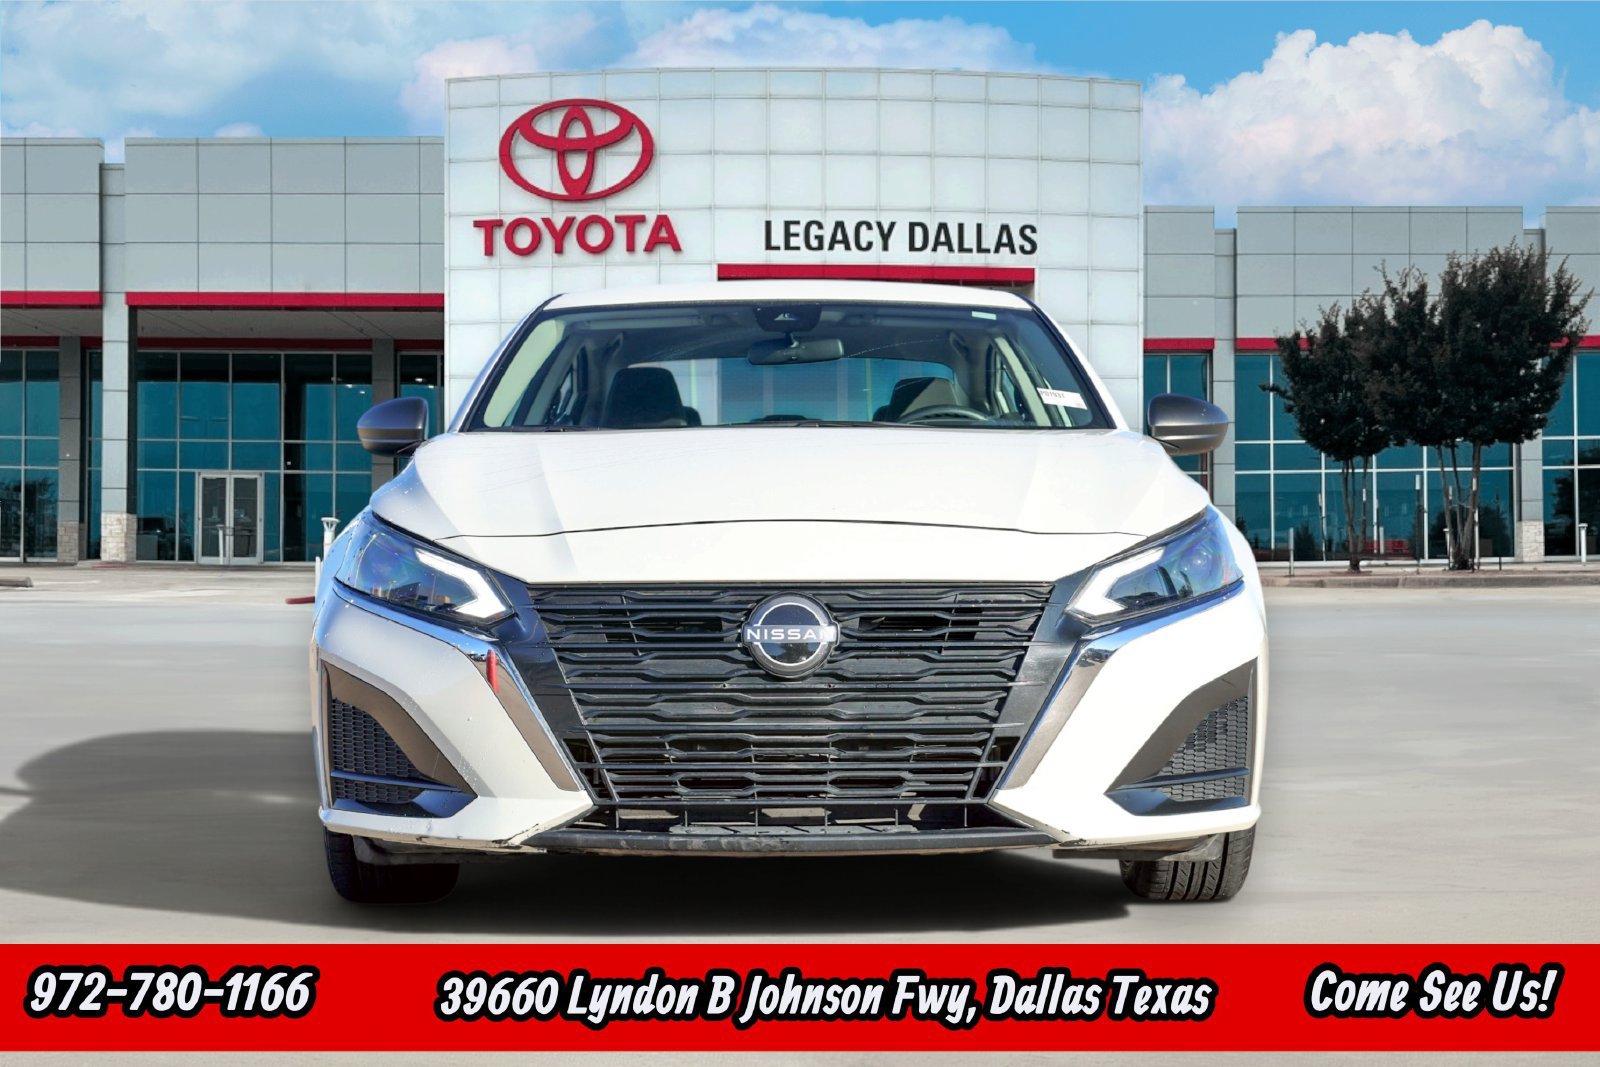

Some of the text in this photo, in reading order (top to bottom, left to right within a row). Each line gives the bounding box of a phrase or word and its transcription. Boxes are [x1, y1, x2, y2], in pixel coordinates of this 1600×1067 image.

[475, 214, 681, 257] TOYOTA
[765, 220, 1038, 255] LEGACY DALLAS
